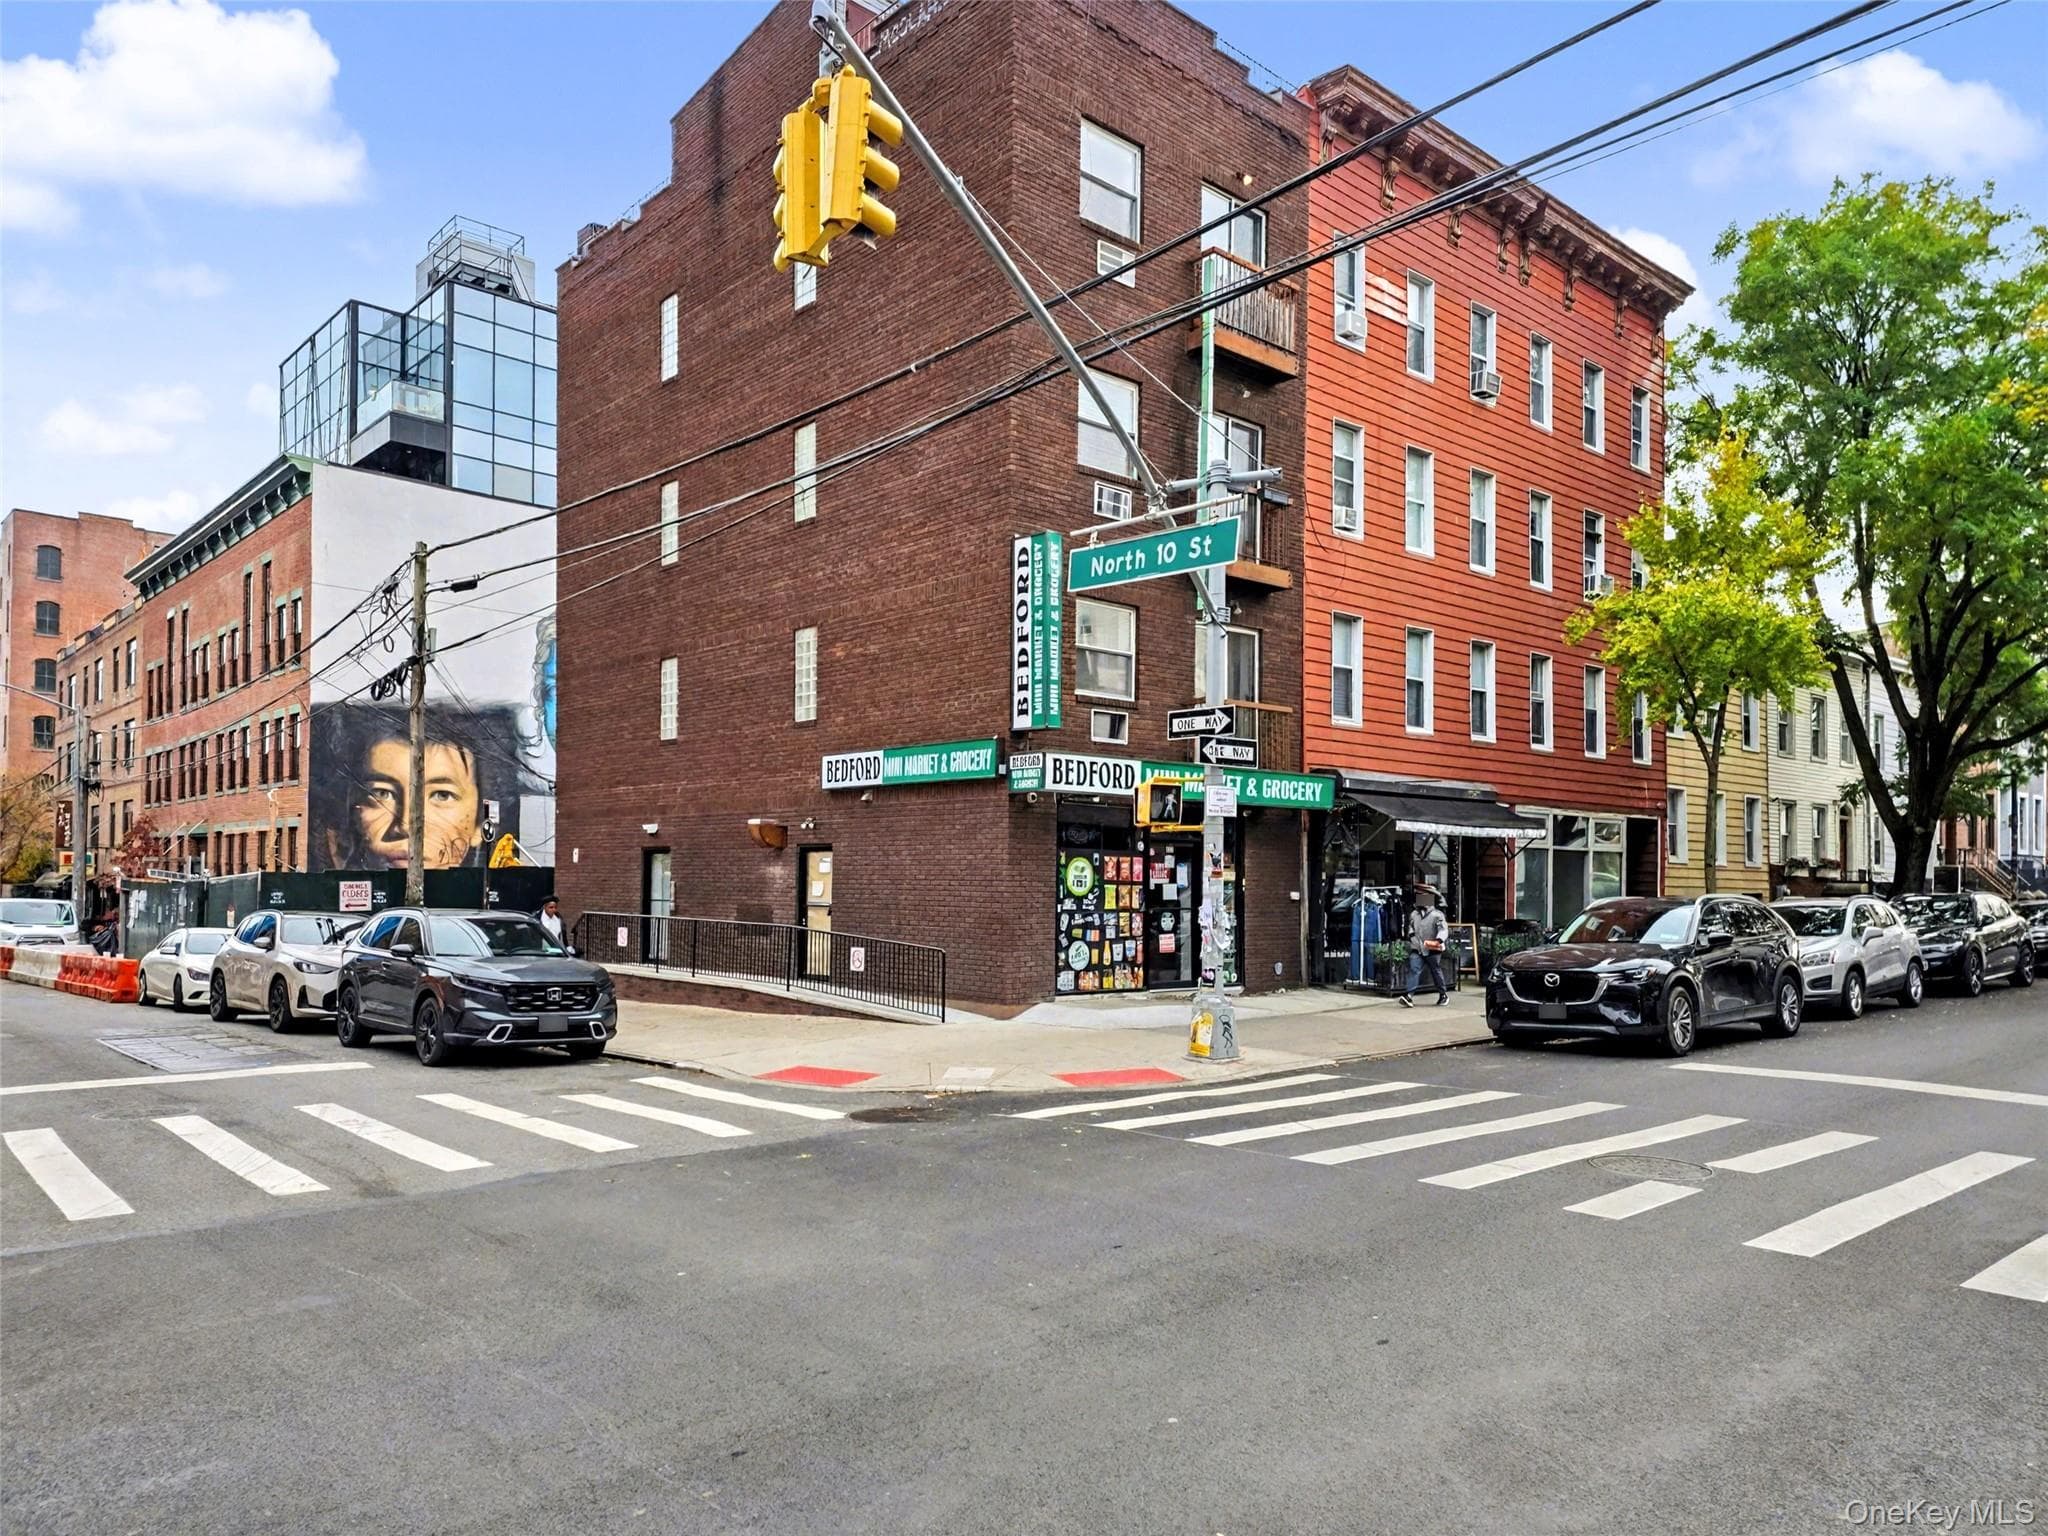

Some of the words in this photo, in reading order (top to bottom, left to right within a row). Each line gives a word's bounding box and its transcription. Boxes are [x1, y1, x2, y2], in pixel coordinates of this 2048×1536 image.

[1091, 549, 1145, 577] North
[1157, 541, 1177, 565] 10
[1188, 534, 1212, 559] St
[1016, 547, 1029, 717] BEDFORD
[1177, 718, 1196, 730] ONE
[1204, 716, 1225, 728] WAY
[826, 756, 881, 783] BEDFORD
[884, 756, 903, 777] MINI
[904, 753, 940, 777] MARKET
[940, 754, 948, 773] &
[950, 748, 993, 773] GROCERY
[1012, 754, 1041, 768] BEDFORD
[1208, 745, 1224, 757] ONE
[1232, 747, 1250, 758] WAY
[1052, 757, 1136, 790] BEDFORD
[1184, 771, 1242, 796] MAET
[1246, 777, 1258, 797] &
[1262, 780, 1323, 802] GROCERY
